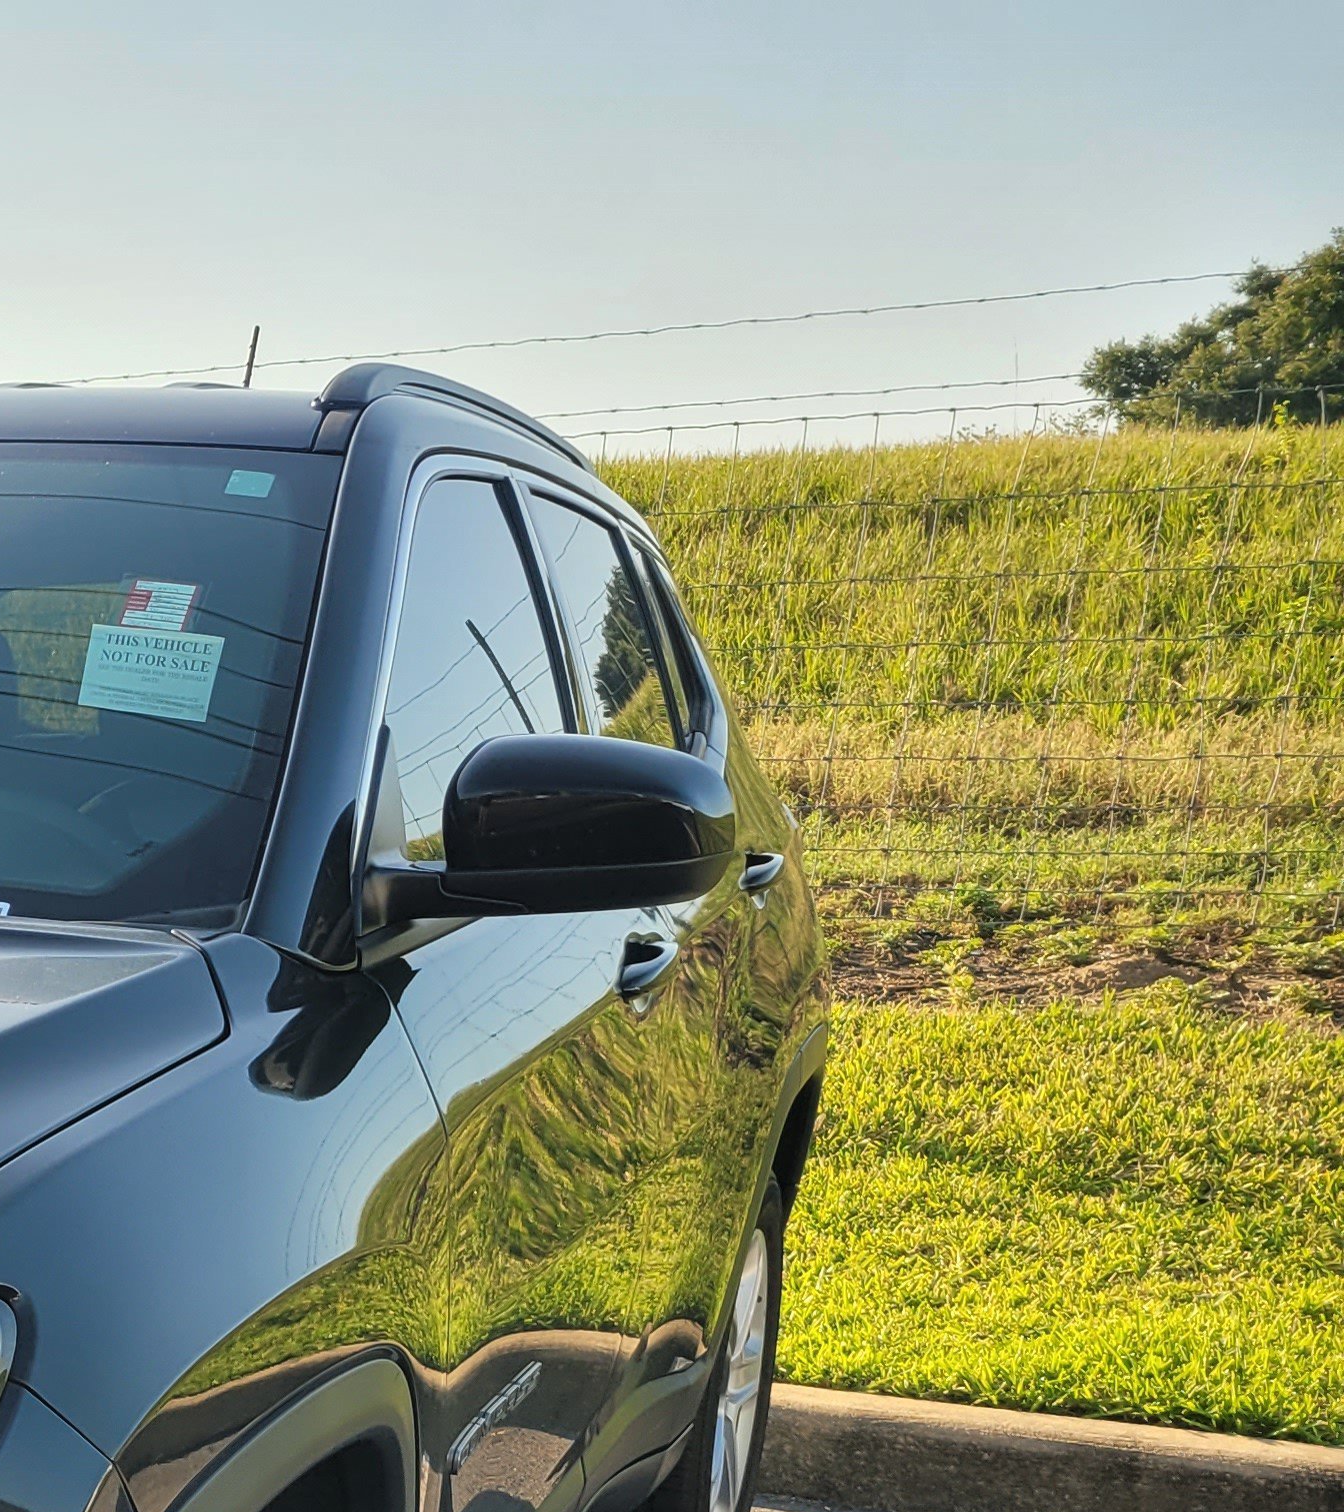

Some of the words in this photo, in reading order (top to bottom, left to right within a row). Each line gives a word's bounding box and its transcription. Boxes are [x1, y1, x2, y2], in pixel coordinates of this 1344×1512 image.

[106, 633, 139, 647] THIS
[144, 637, 212, 655] VEHICLE
[100, 649, 132, 663] NOT
[135, 653, 166, 668] FOR
[170, 657, 212, 673] SALE
